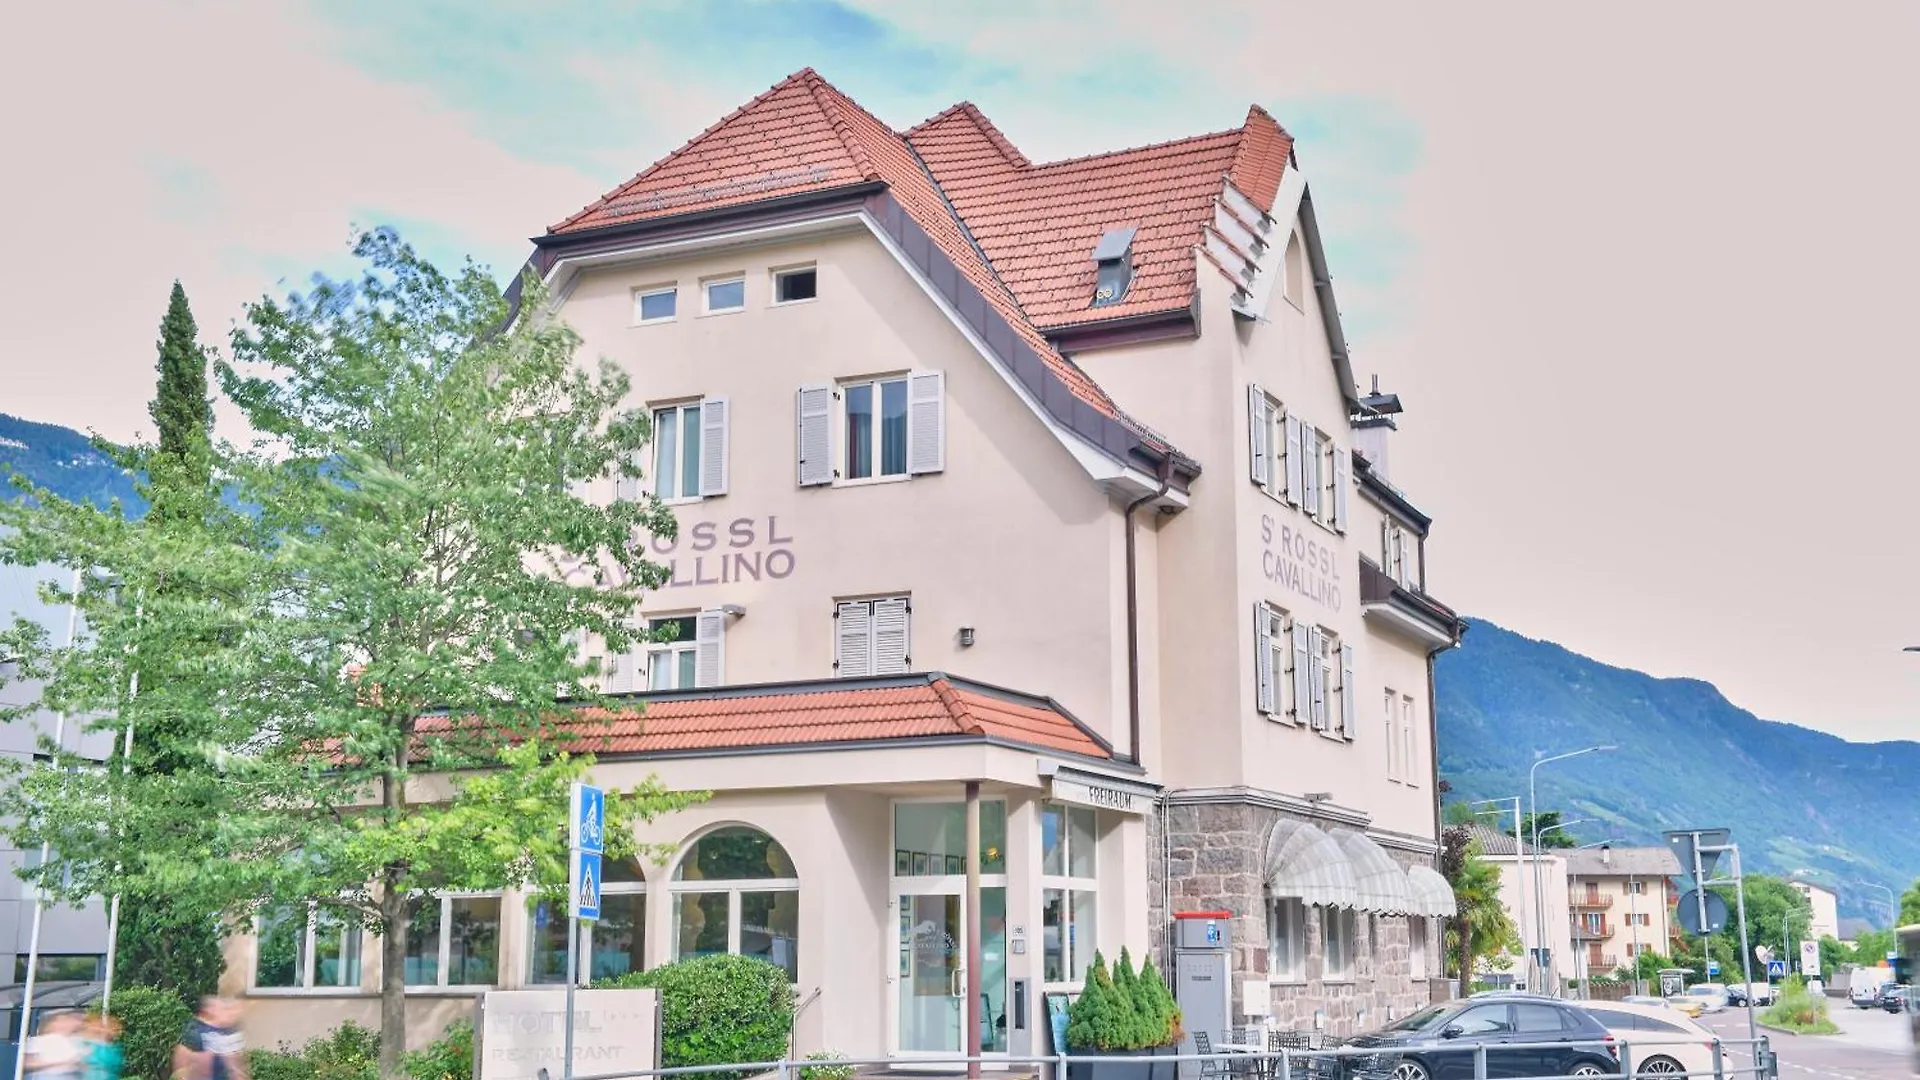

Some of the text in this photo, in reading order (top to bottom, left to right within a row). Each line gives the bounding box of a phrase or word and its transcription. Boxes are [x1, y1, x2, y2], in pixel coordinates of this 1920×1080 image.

[1262, 549, 1341, 613] CAVALLINO
[1089, 786, 1131, 810] FREIRAUM
[492, 1046, 625, 1061] RESTAURANT
